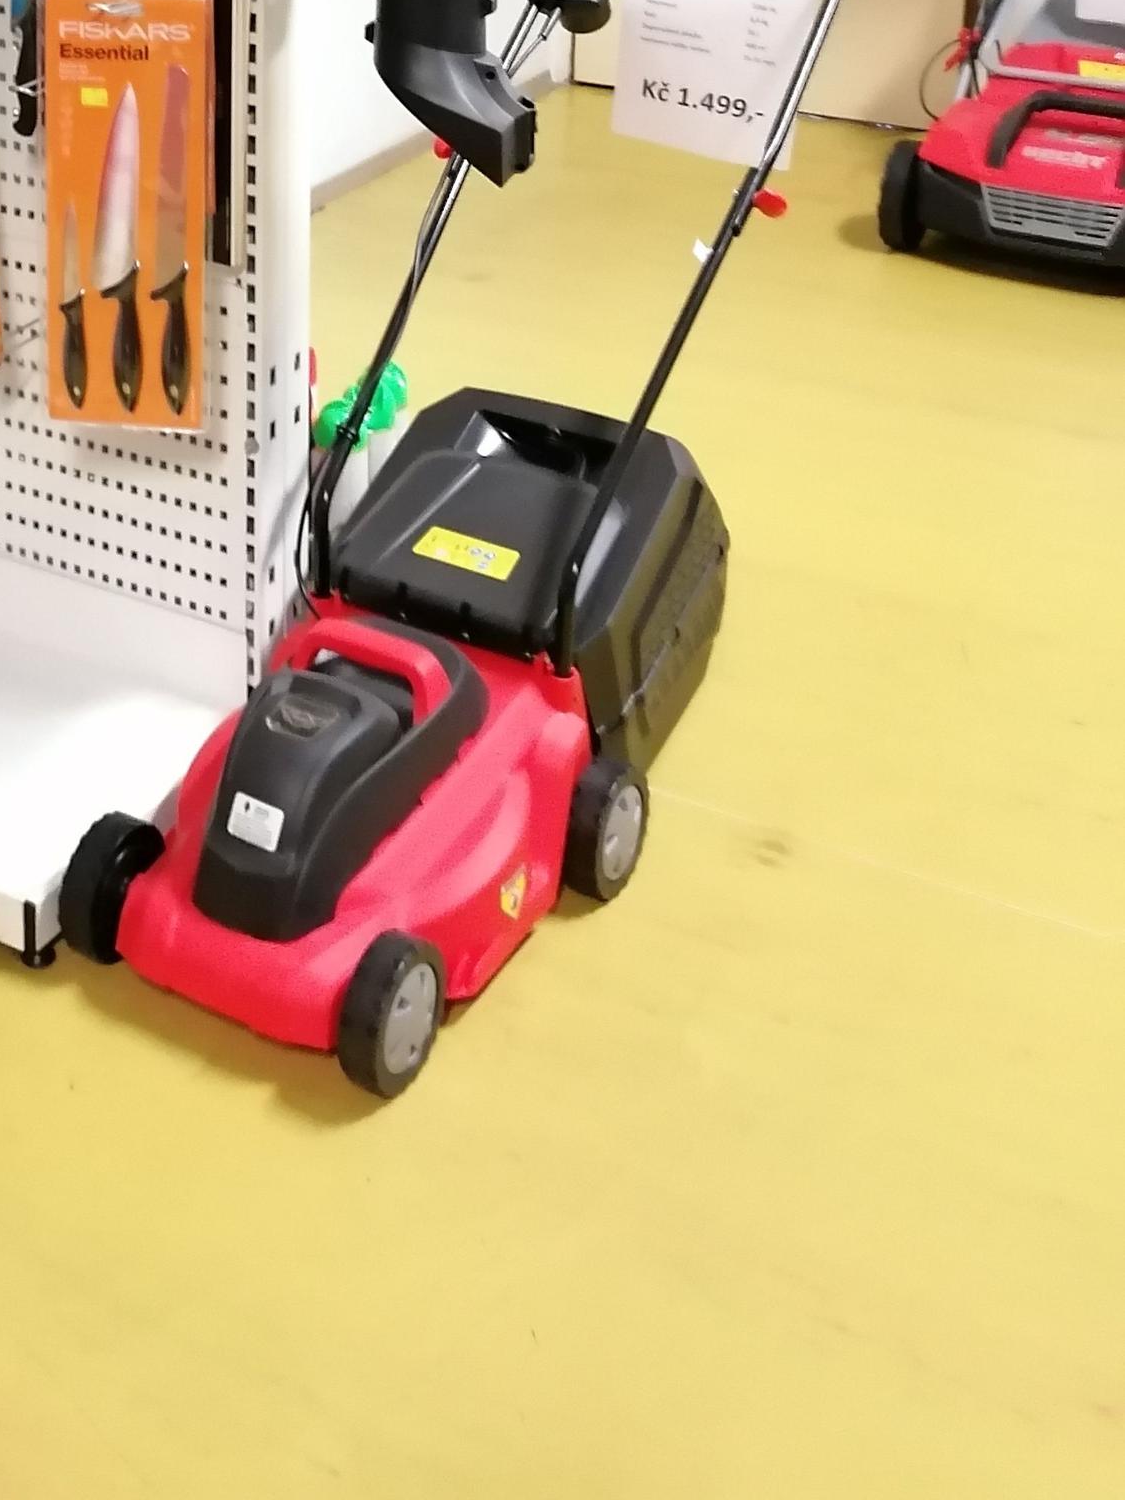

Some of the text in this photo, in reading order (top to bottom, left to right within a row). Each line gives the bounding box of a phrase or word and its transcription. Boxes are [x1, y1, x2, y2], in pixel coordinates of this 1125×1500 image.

[58, 20, 191, 41] FISKARS
[59, 43, 149, 61] Essential
[642, 78, 764, 123] Kč 1.499,-
